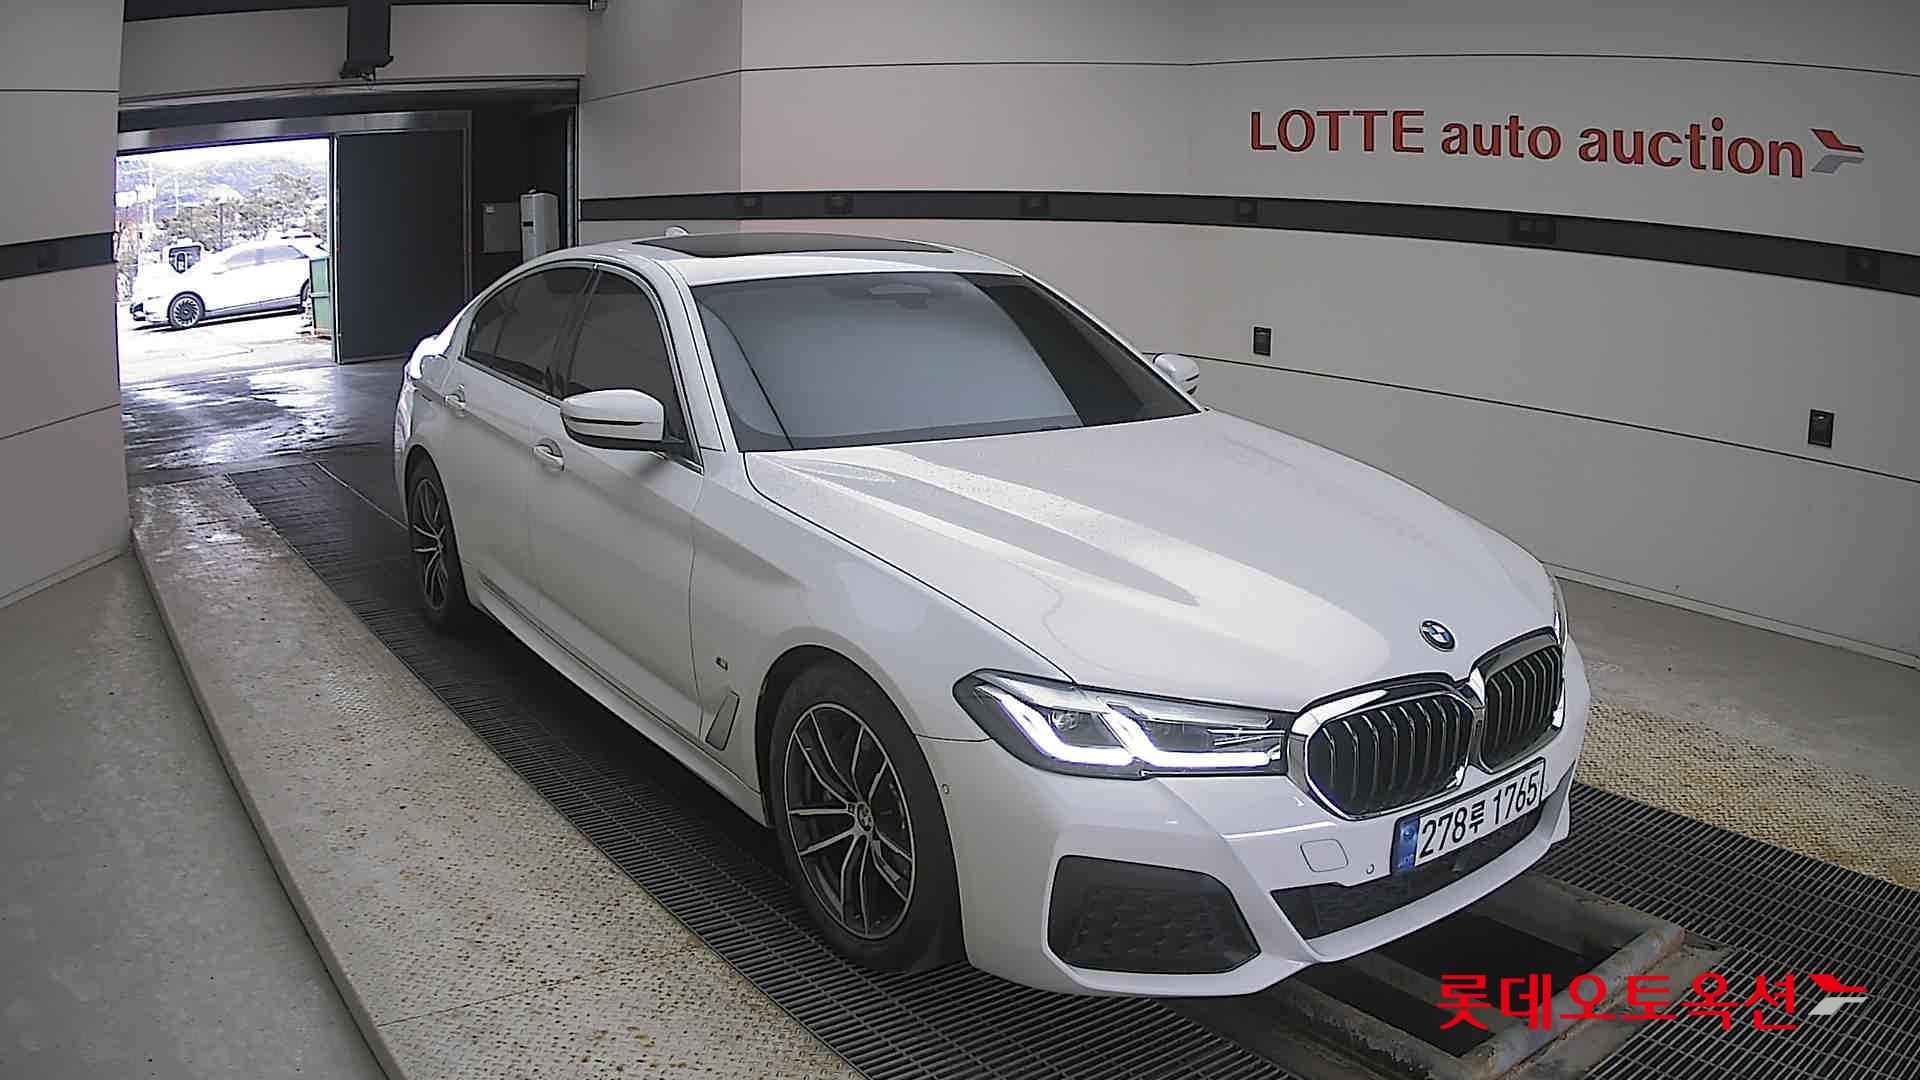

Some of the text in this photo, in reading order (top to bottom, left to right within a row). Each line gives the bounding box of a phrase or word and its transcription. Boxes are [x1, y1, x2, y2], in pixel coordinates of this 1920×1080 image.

[1251, 110, 1803, 178] LOTTE auto auction
[1419, 770, 1540, 858] 278루 1765
